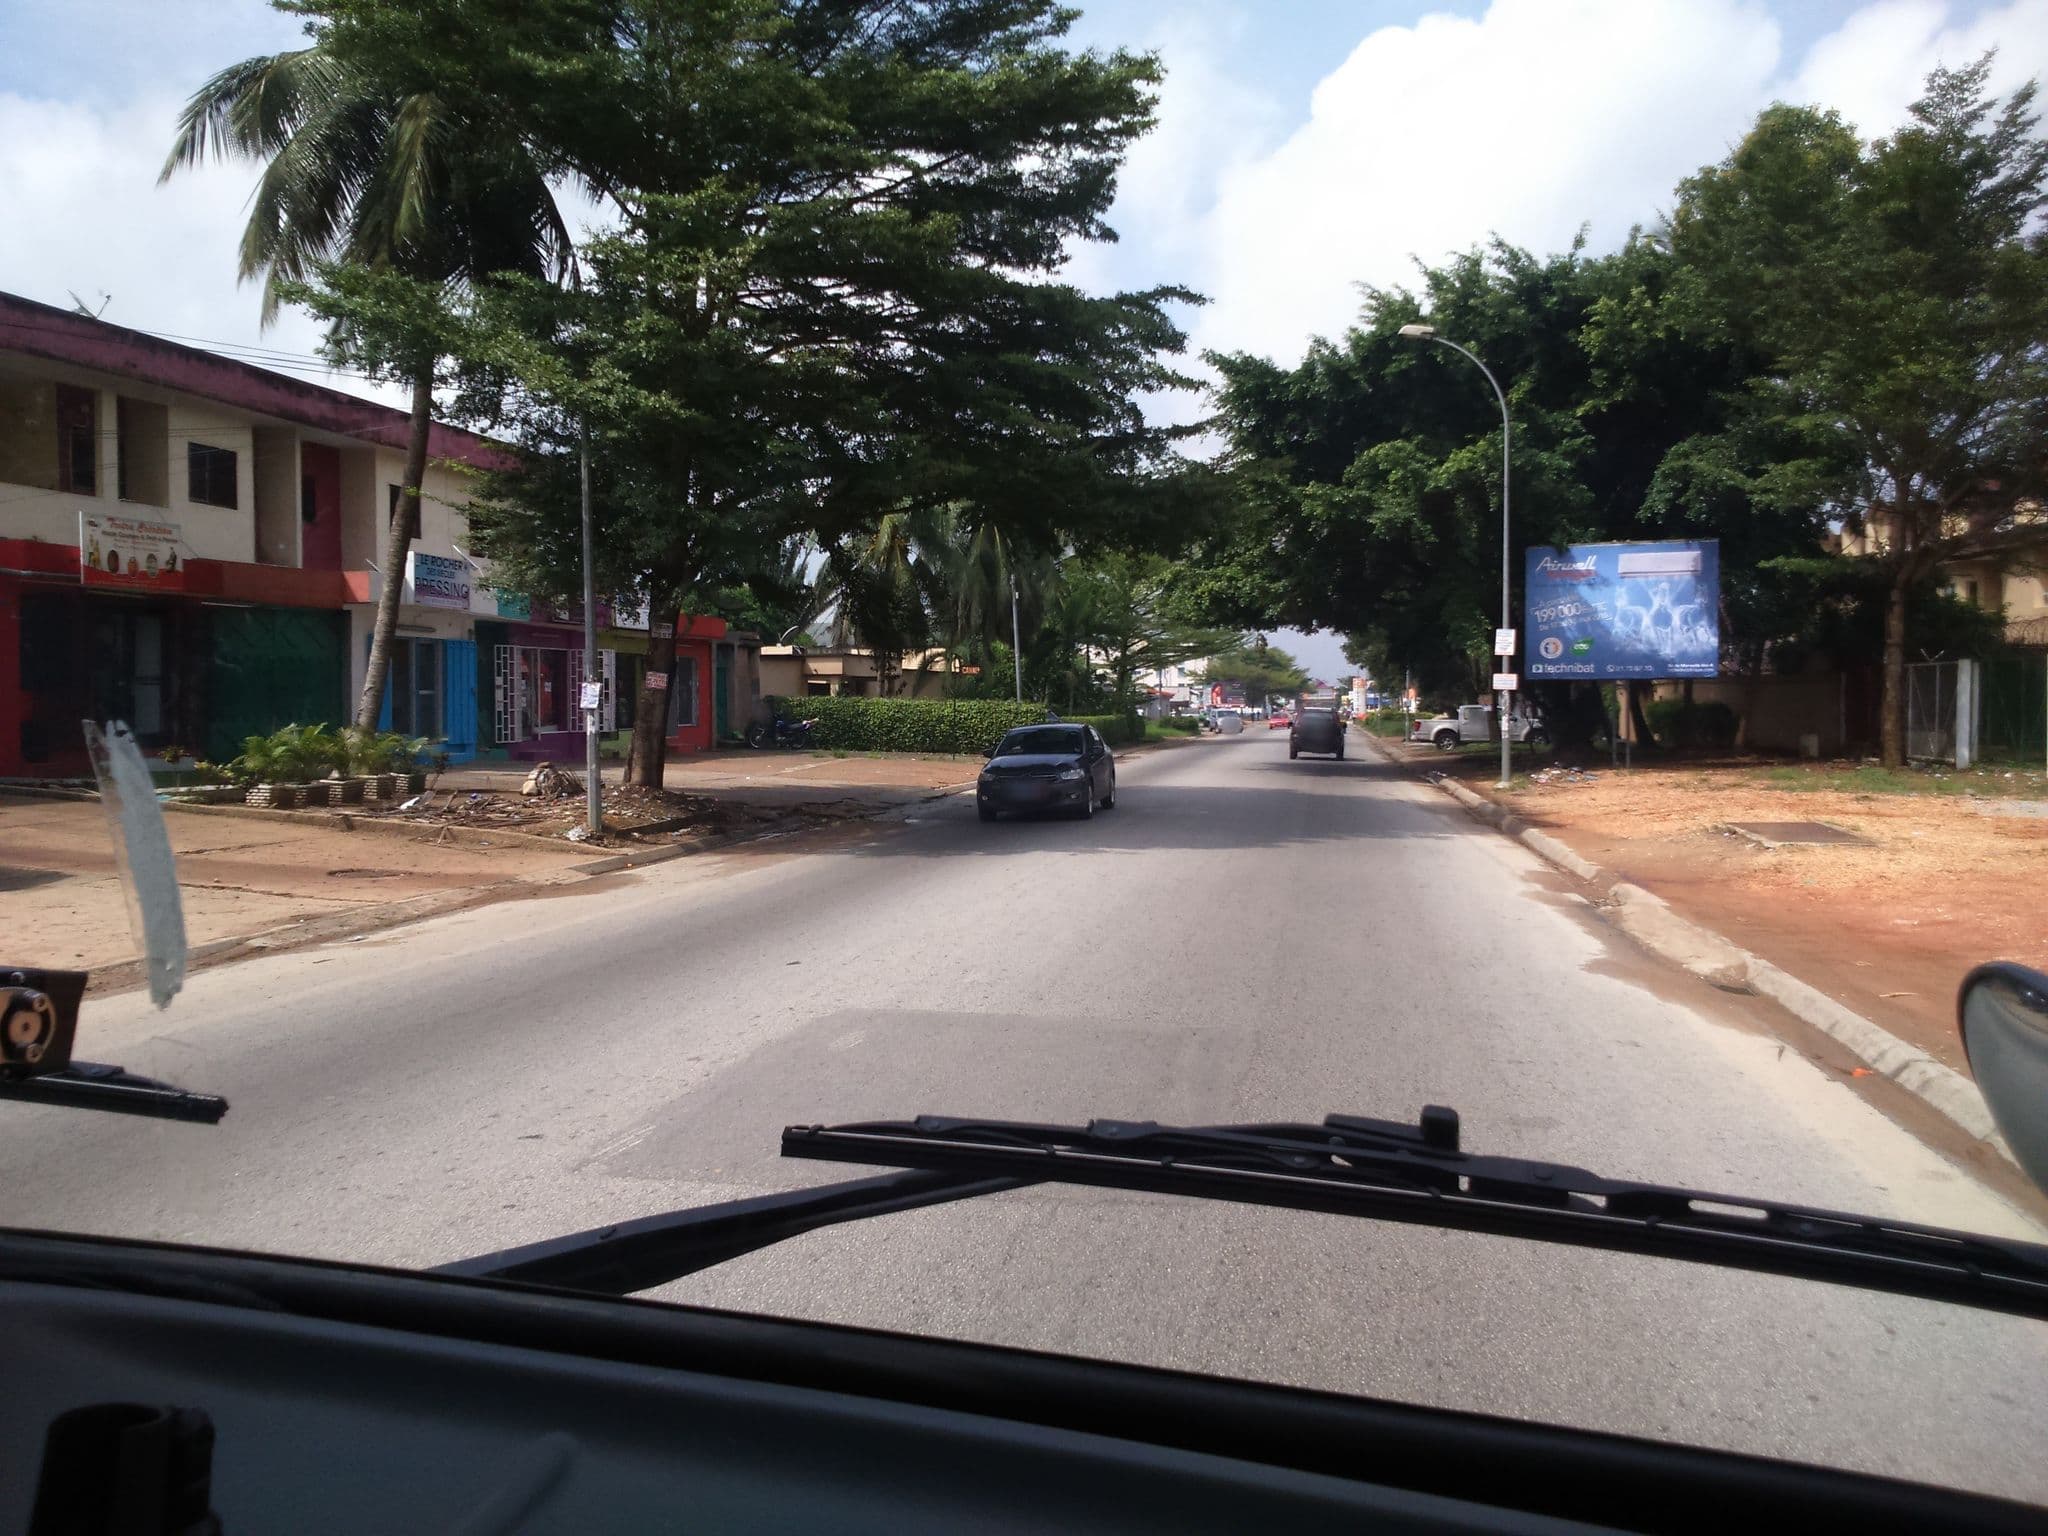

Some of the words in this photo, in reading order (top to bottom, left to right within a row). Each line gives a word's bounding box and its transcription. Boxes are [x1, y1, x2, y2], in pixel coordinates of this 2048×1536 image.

[431, 556, 463, 571] ROCHER
[1535, 555, 1597, 572] Airwell
[415, 577, 470, 599] PRESSING
[1534, 607, 1556, 623] 199
[1557, 602, 1581, 618] 000
[1544, 663, 1595, 673] technibat
